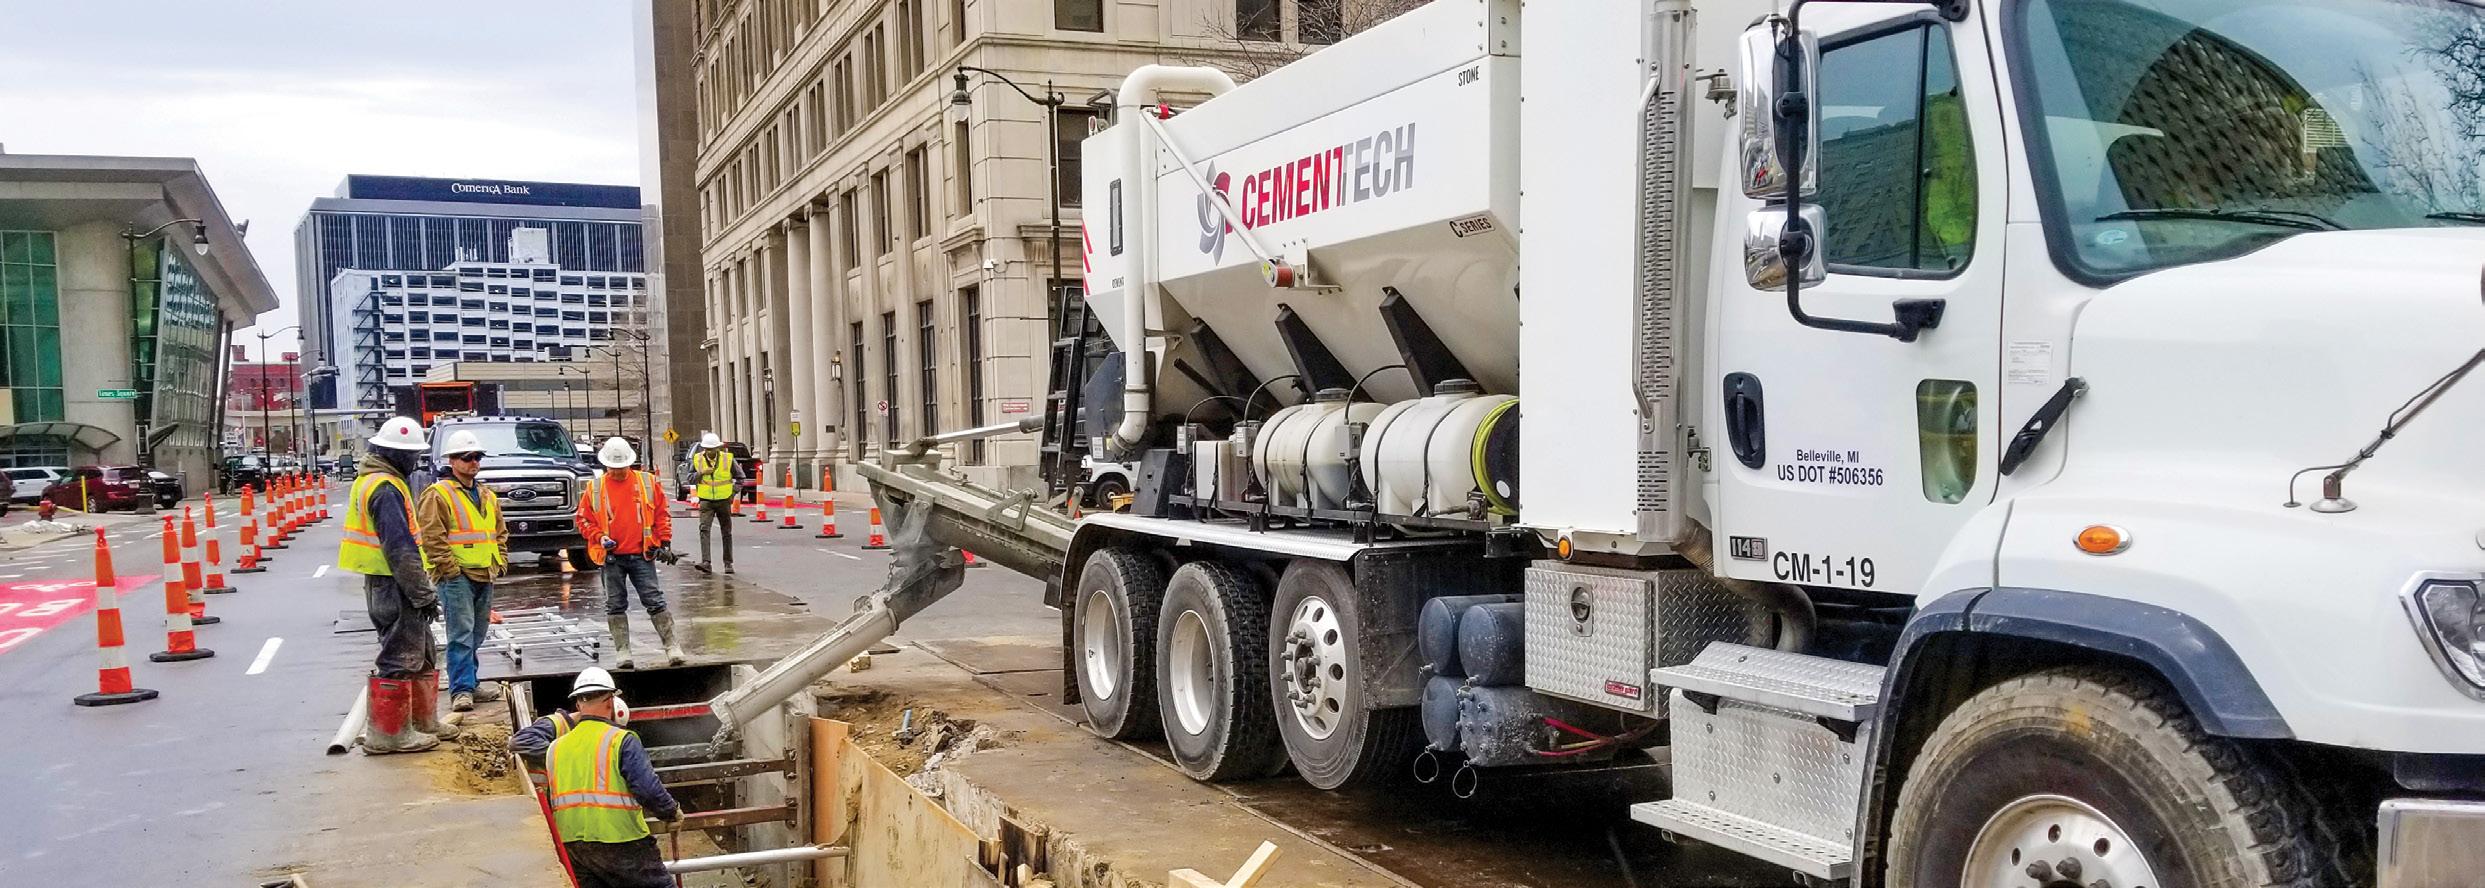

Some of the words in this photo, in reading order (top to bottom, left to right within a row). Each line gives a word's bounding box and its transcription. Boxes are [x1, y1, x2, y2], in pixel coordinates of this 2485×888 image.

[1458, 65, 1479, 87] STONE
[503, 184, 530, 195] Bank
[1449, 220, 1463, 238] C
[1459, 217, 1491, 233] SERIES
[1796, 449, 1844, 464] Belleville,
[1847, 451, 1859, 463] MI
[1777, 464, 1795, 481] US
[1798, 465, 1825, 483] DOT
[1828, 466, 1884, 486] #506356
[1773, 551, 1875, 588] CM-1-19
